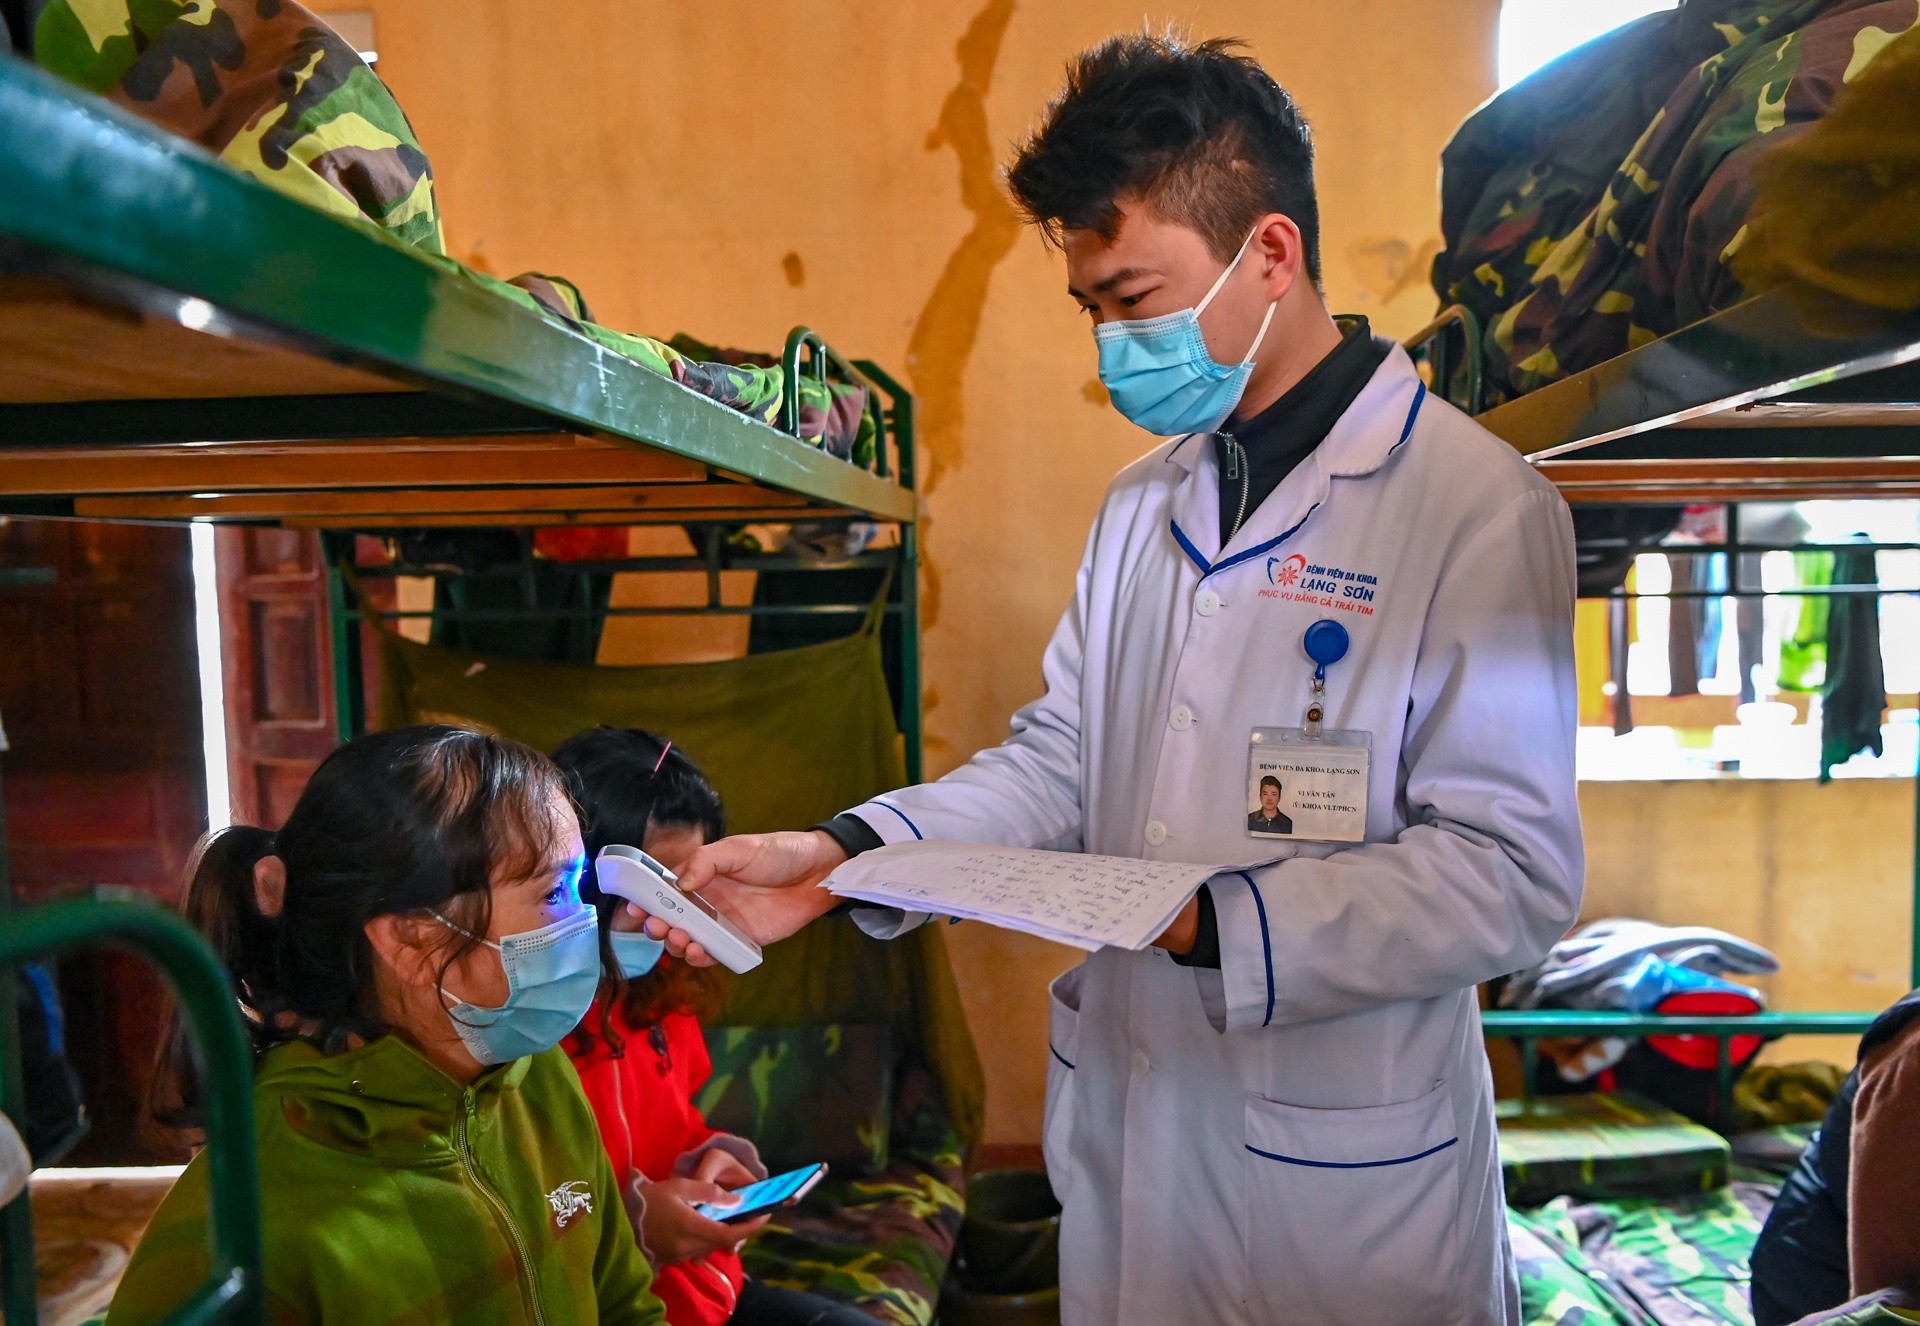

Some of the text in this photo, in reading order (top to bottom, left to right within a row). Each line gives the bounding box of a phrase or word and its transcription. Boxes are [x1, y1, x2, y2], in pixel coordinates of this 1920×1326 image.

[1306, 564, 1326, 575] BỆNH
[1326, 567, 1344, 579] VIỆN
[1356, 573, 1377, 585] KHOA
[1258, 588, 1279, 599] PHỤC
[1281, 591, 1294, 602] VỤ
[1320, 596, 1333, 607] CẢ
[1334, 600, 1355, 612] TRÁI
[1357, 604, 1374, 616] TIM
[1300, 577, 1375, 602] LẠNG SƠN
